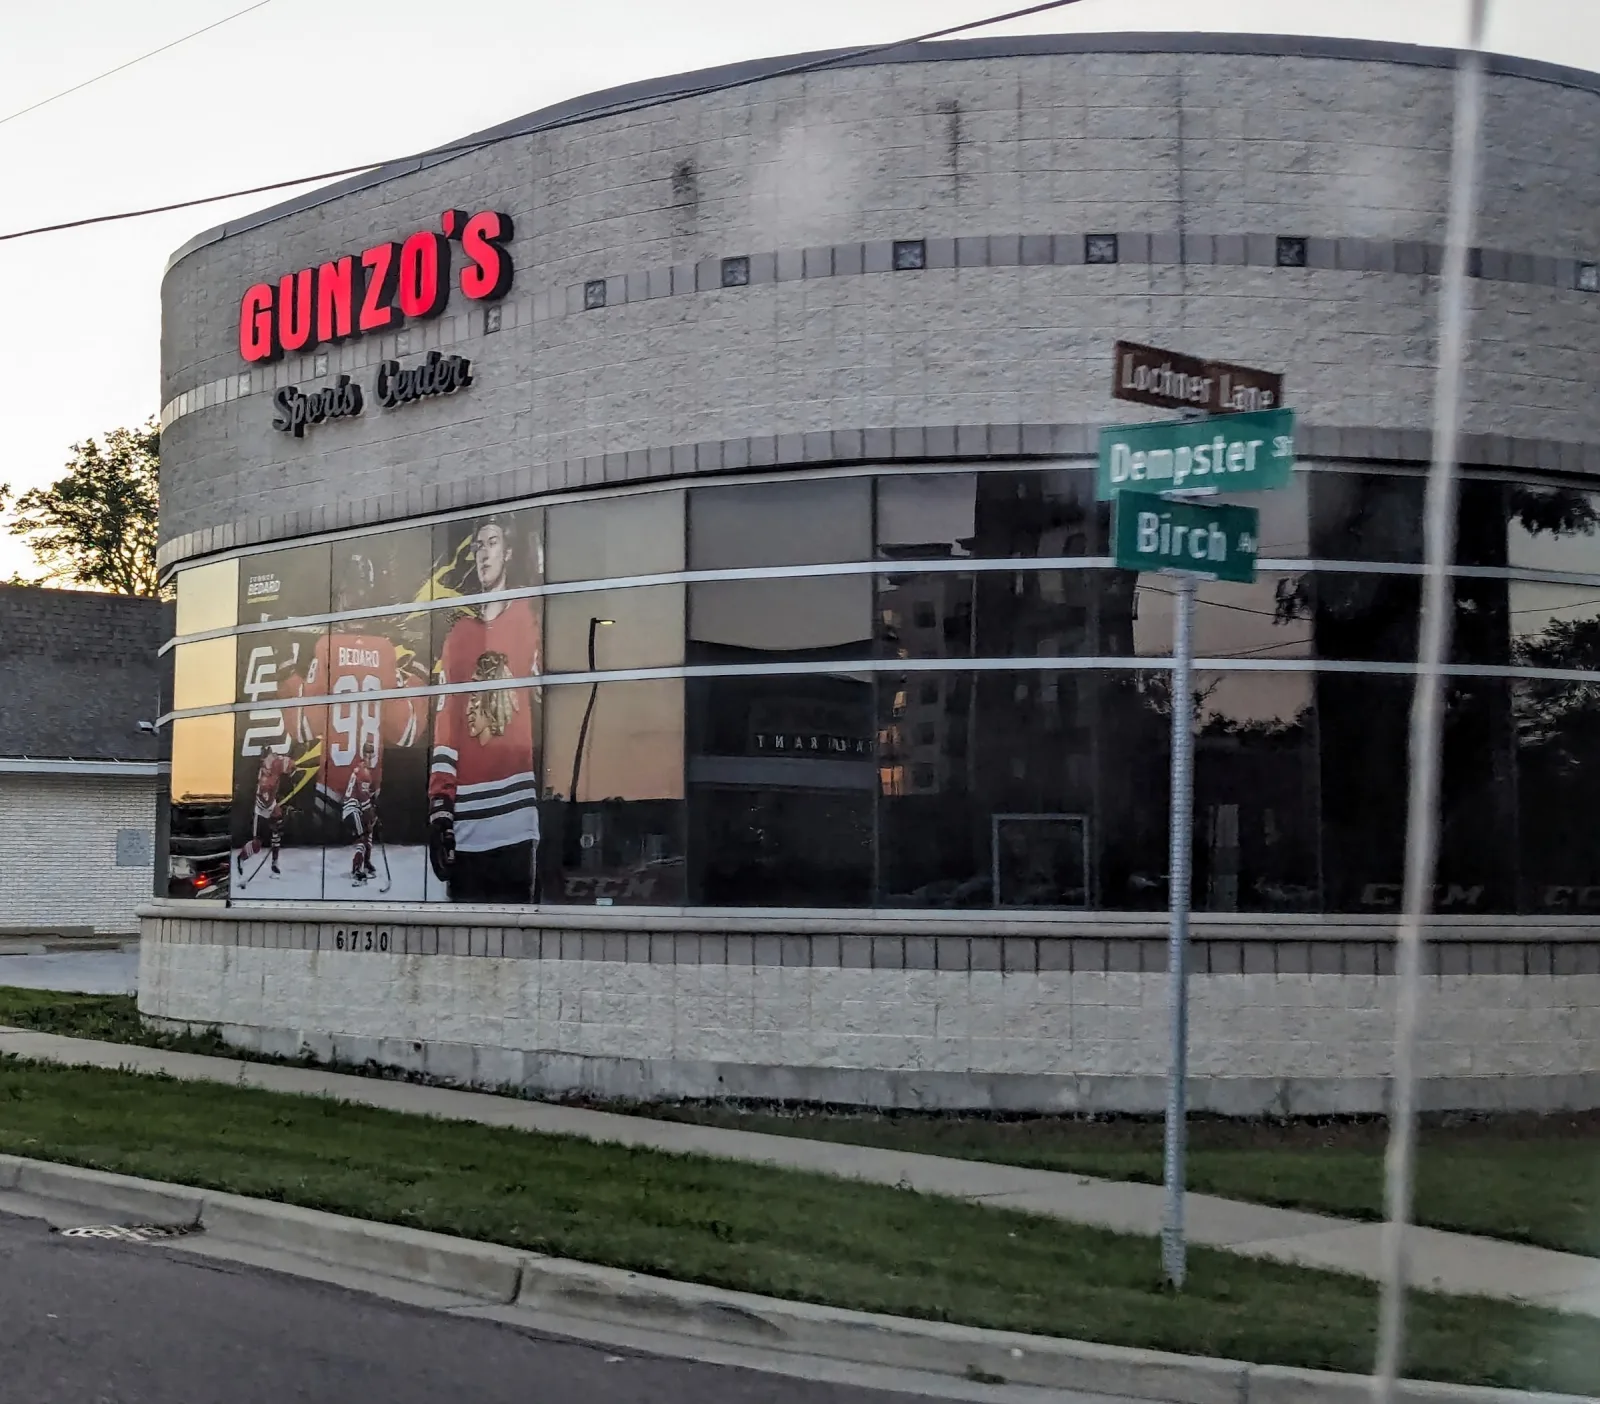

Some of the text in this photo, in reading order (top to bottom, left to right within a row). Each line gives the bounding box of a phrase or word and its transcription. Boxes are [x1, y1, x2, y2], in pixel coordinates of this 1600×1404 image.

[239, 208, 513, 363] GUNZO'S
[272, 351, 474, 438] Sports Center
[1219, 374, 1275, 411] Lane
[1110, 435, 1264, 486] Dempster
[1137, 511, 1227, 562] Birch
[331, 675, 380, 769] 98
[336, 930, 388, 951] 6730
